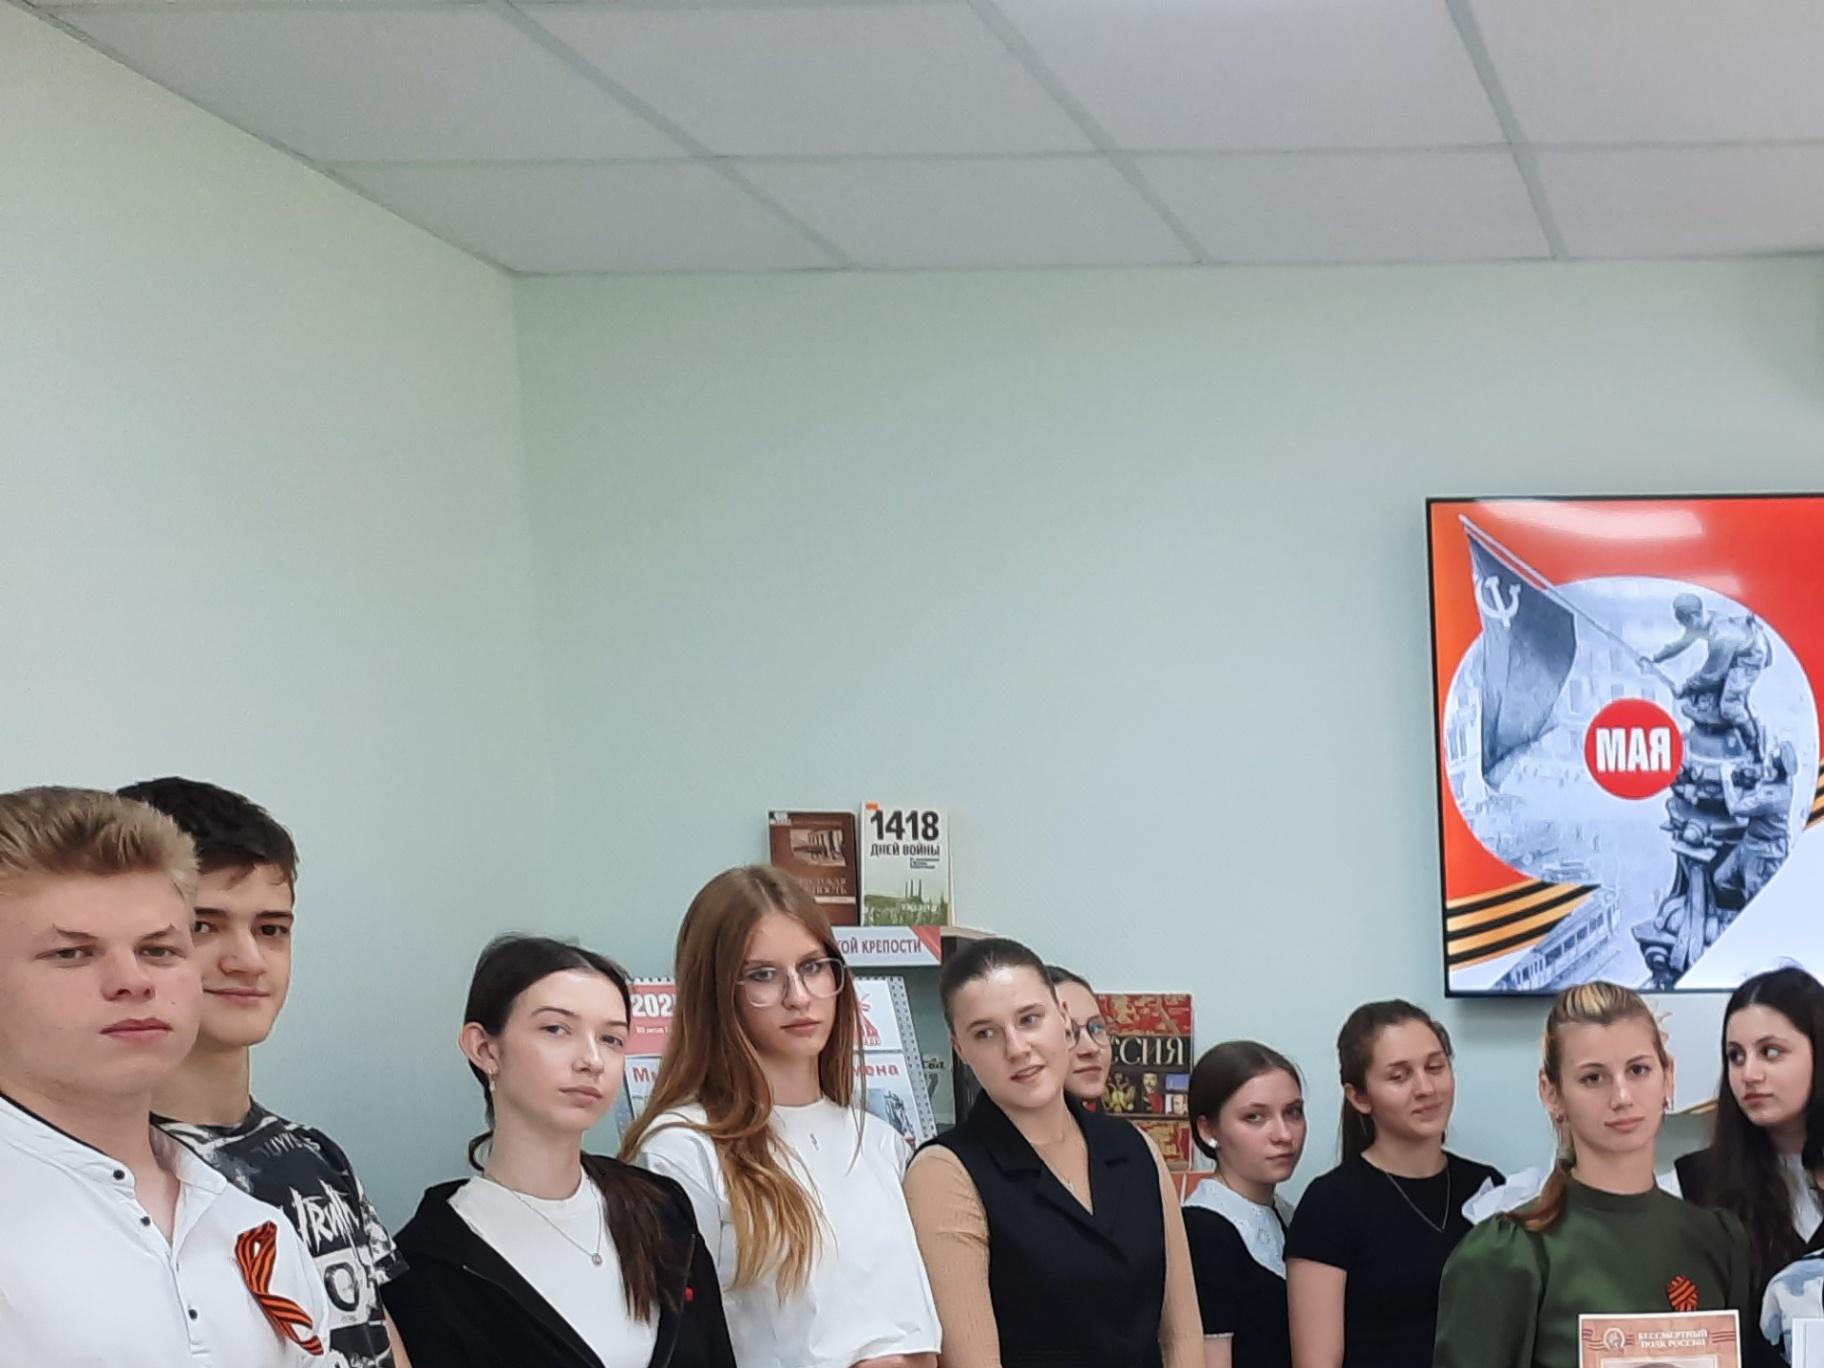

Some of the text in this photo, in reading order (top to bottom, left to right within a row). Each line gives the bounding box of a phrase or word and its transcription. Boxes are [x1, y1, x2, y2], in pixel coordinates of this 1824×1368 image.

[1596, 727, 1672, 773] МАЯ
[870, 810, 939, 841] 1418
[870, 843, 940, 857] ДНЕЙ ВОЙНЫ
[838, 937, 922, 954] ОЙ КРЕПОСТИ
[630, 992, 676, 1018] 202
